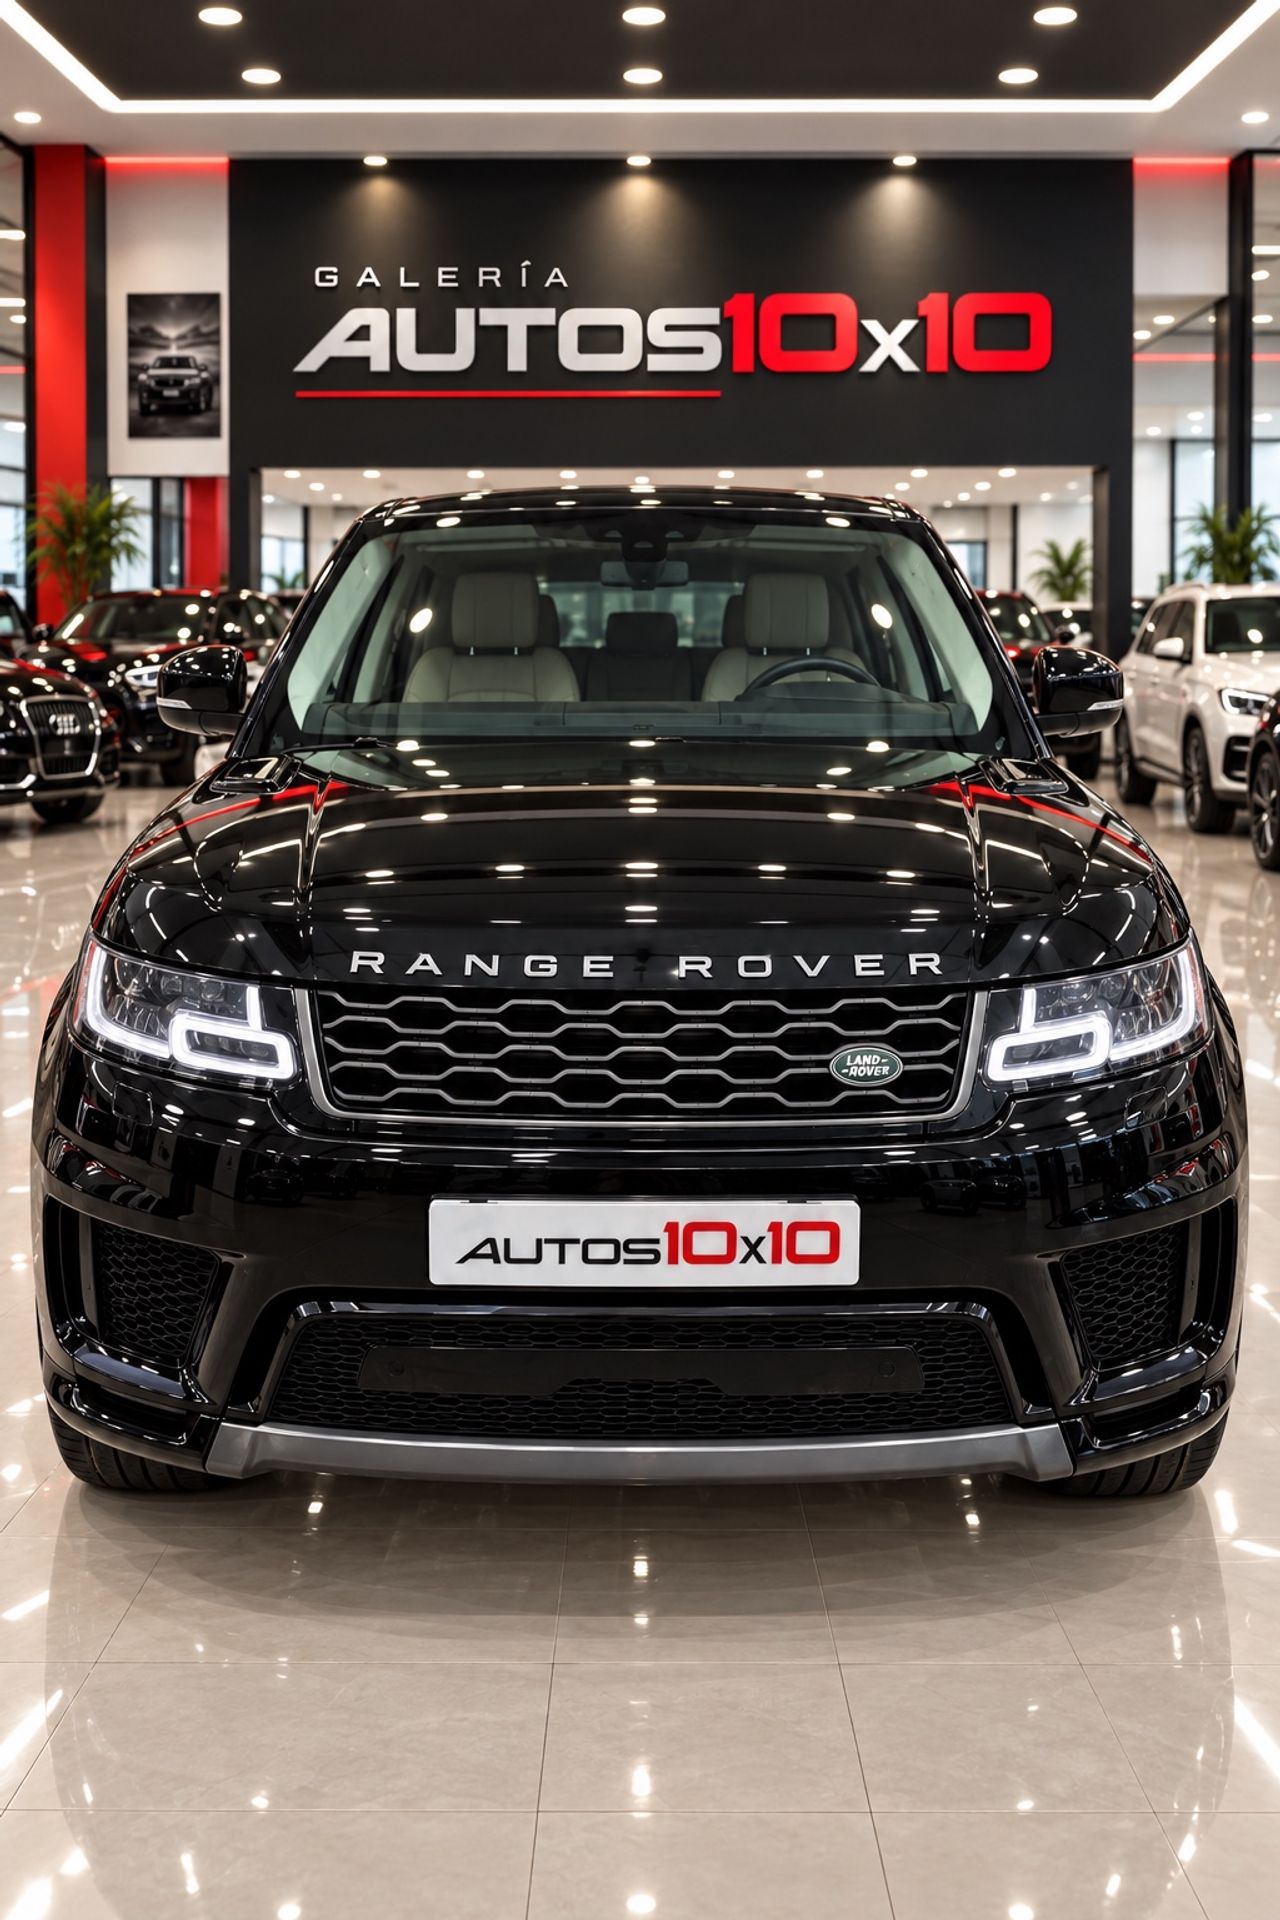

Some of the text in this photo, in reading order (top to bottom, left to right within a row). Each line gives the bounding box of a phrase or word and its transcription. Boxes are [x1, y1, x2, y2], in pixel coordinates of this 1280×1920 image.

[314, 260, 569, 288] GALERÍA
[294, 292, 1053, 372] AUTOS10x10
[350, 951, 943, 978] RANGE ROVER
[456, 1221, 841, 1265] AUTOS10x10
